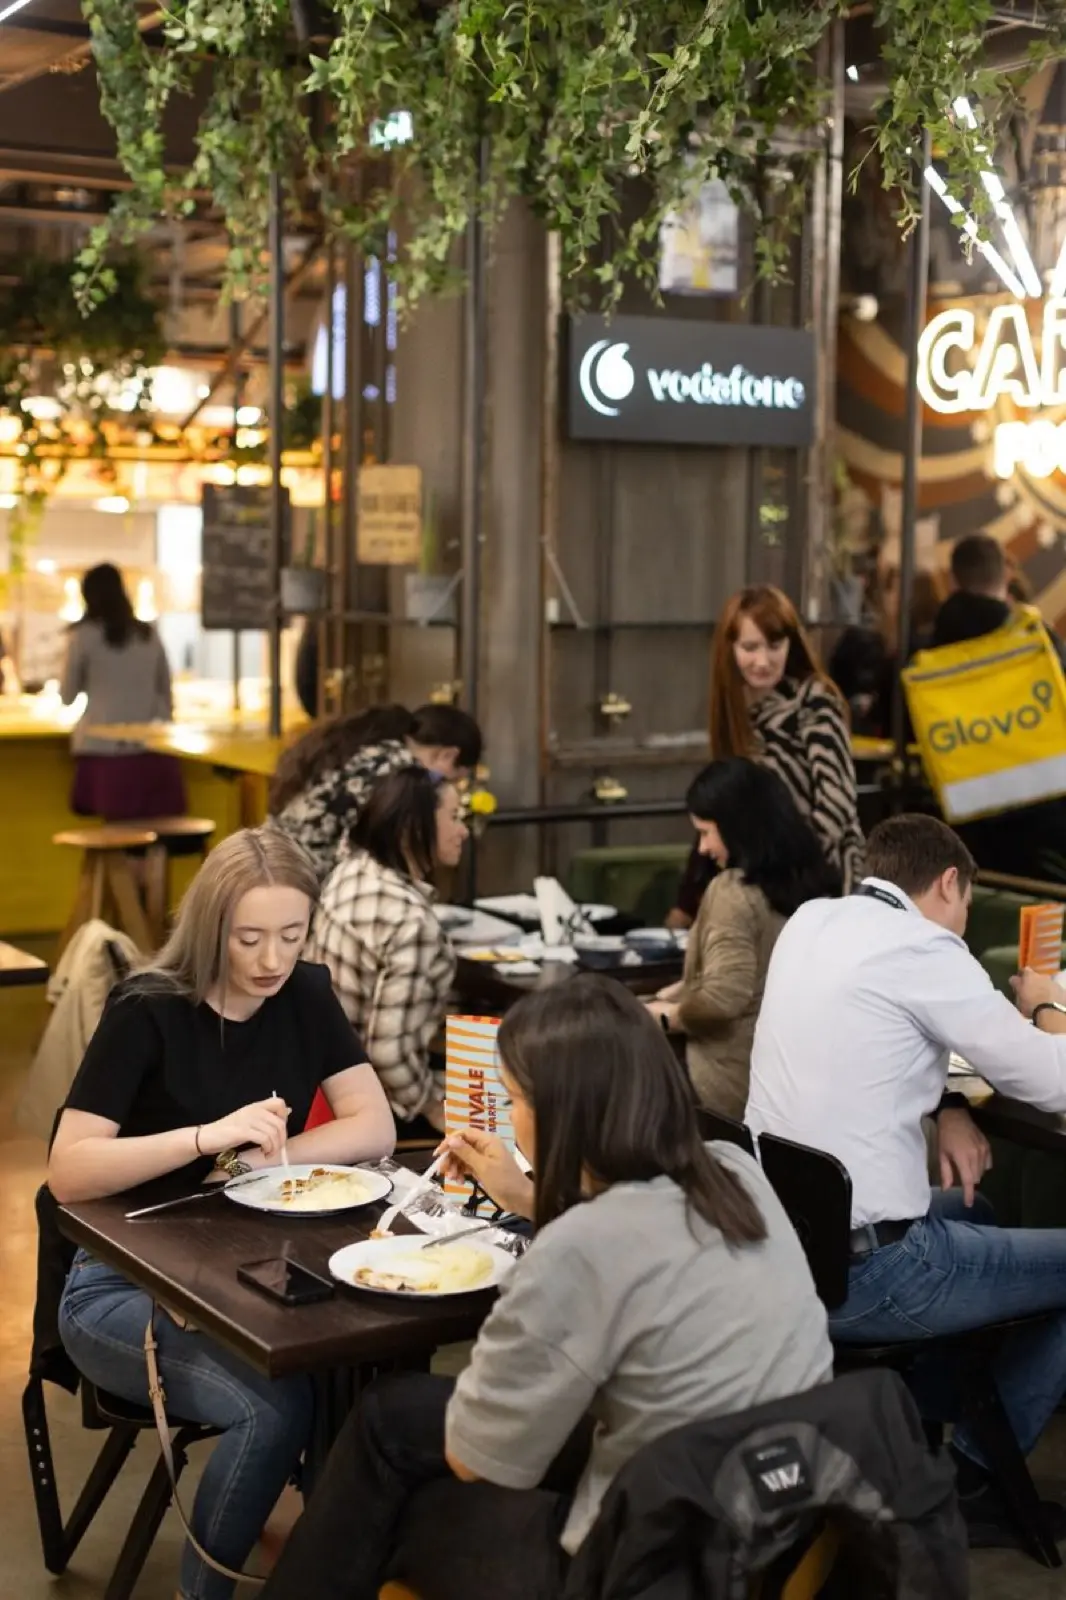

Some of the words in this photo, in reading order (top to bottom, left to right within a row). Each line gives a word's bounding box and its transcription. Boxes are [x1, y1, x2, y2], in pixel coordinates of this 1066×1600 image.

[648, 362, 805, 408] vodafone
[994, 419, 1066, 478] FO
[928, 704, 1042, 754] Glovo
[487, 1091, 497, 1133] MARKET
